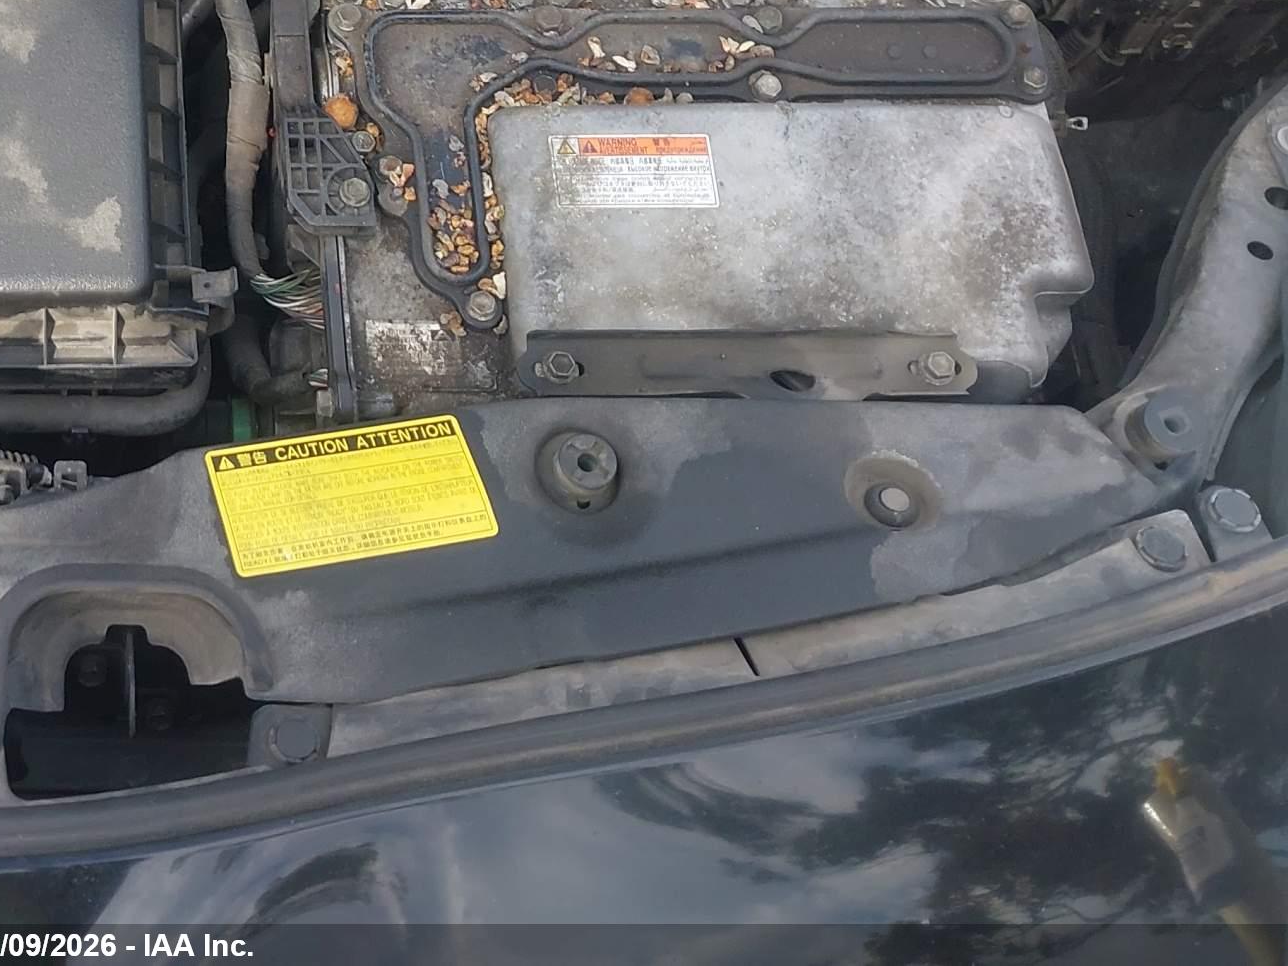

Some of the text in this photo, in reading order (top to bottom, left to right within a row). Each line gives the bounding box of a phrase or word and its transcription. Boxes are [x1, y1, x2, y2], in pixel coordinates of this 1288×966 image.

[597, 137, 638, 147] WARNING
[274, 437, 349, 462] CAUTION
[355, 421, 453, 450] ATTENTION
